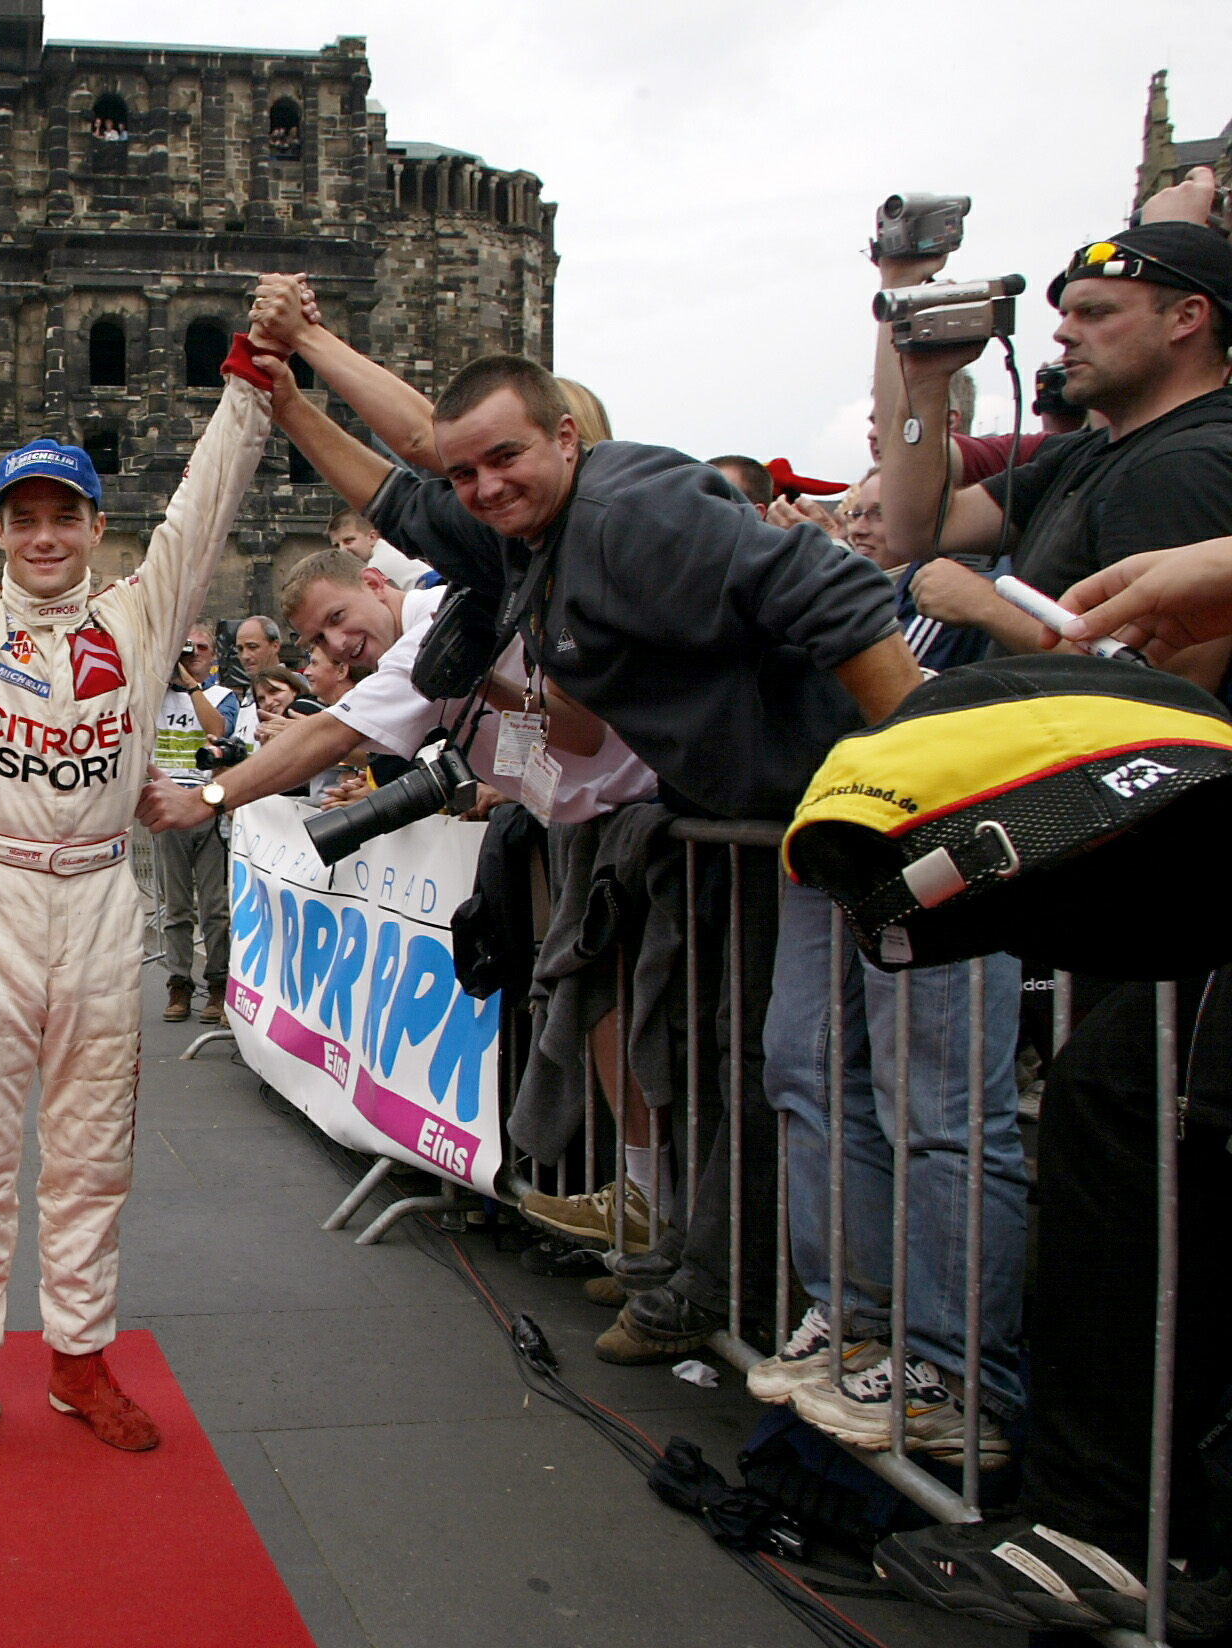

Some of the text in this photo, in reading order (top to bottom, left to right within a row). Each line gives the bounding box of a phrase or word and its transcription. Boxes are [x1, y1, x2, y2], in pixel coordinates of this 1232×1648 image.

[18, 452, 75, 466] MICHELIN
[12, 641, 37, 653] TAL
[1022, 977, 1055, 992] das
[234, 985, 257, 1022] Eins
[324, 1041, 349, 1090] Eins
[416, 1117, 471, 1176] Eins
